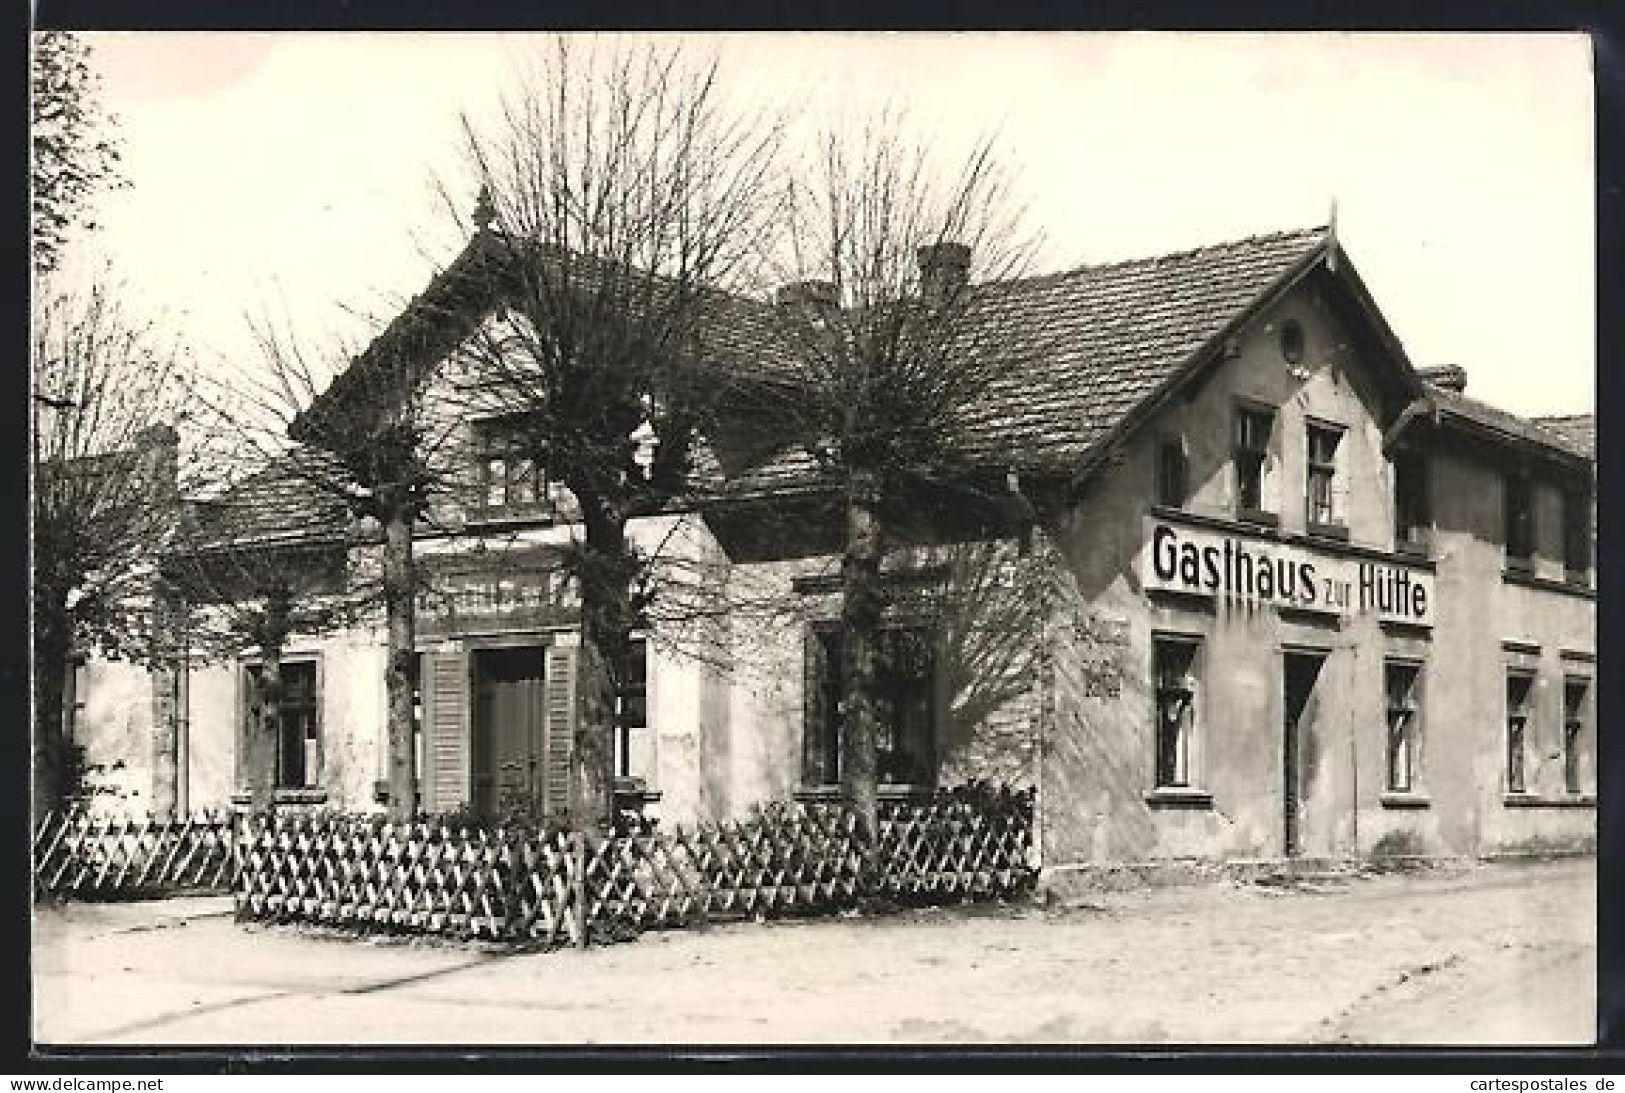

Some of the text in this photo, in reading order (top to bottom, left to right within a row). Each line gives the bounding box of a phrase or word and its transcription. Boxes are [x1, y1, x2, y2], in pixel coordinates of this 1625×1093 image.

[1153, 524, 1427, 618] Gasthaus zur Hütte
